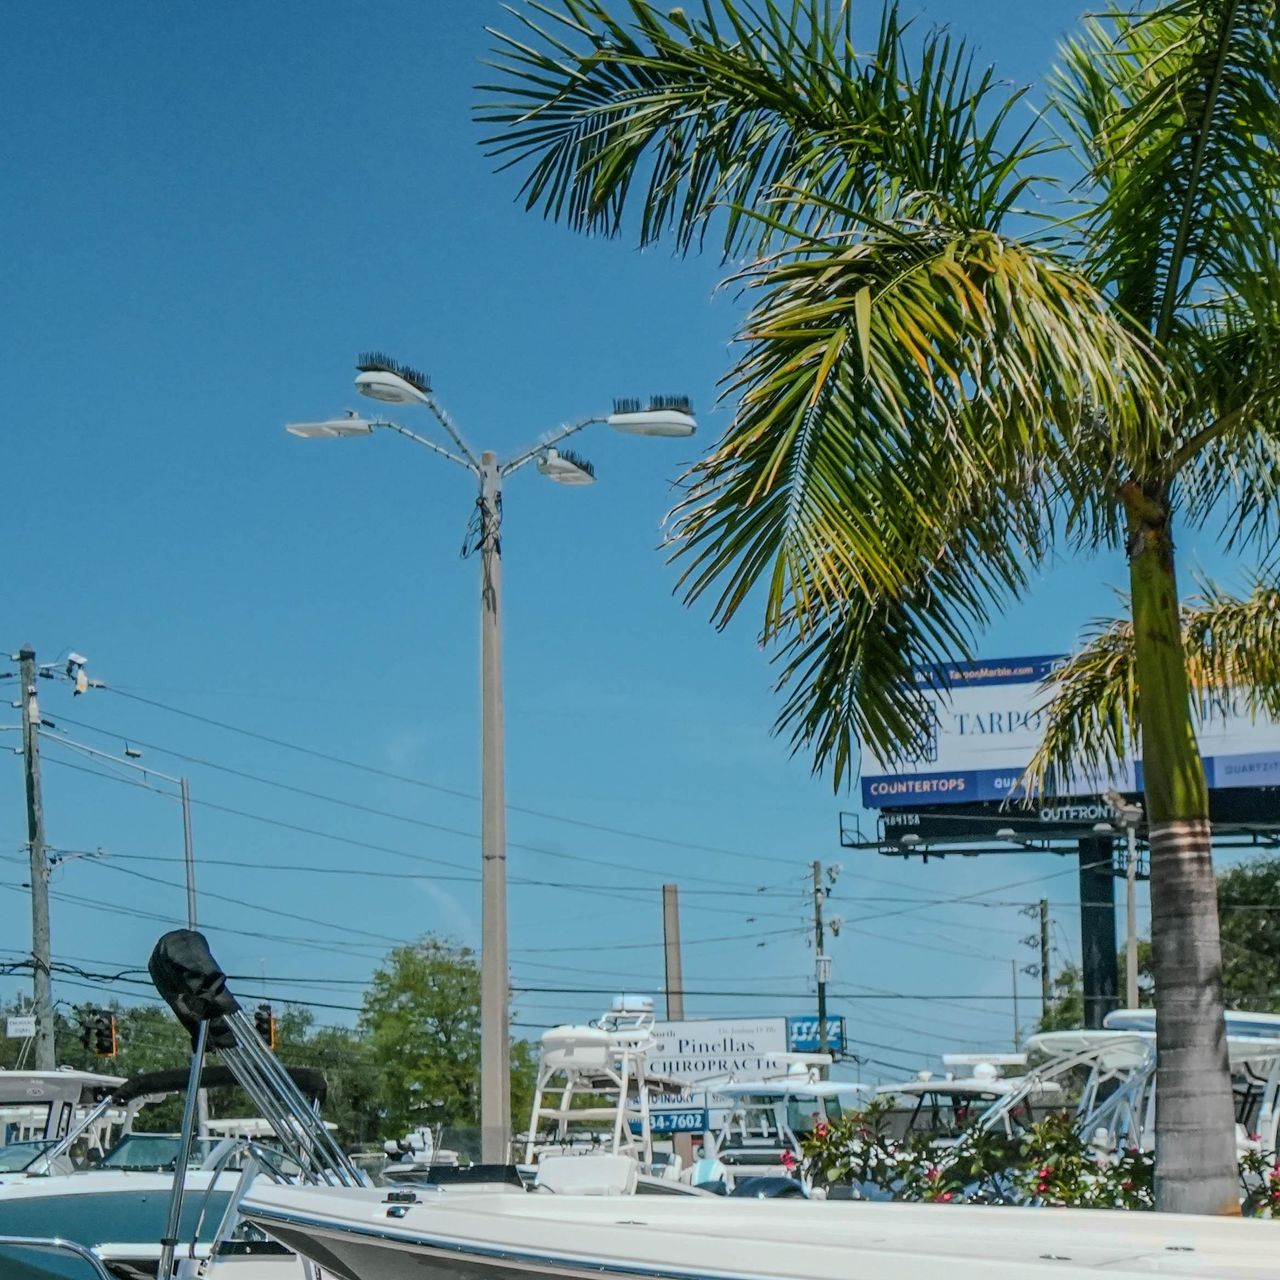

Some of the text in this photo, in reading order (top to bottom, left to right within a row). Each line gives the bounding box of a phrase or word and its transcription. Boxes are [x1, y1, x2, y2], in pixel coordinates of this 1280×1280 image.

[954, 710, 1047, 736] TARPO
[870, 778, 965, 795] COUNTERTOPS
[678, 1038, 755, 1054] Pinellas
[650, 1058, 782, 1073] CHIROPRACTIC
[648, 1114, 702, 1129] 34-7602
